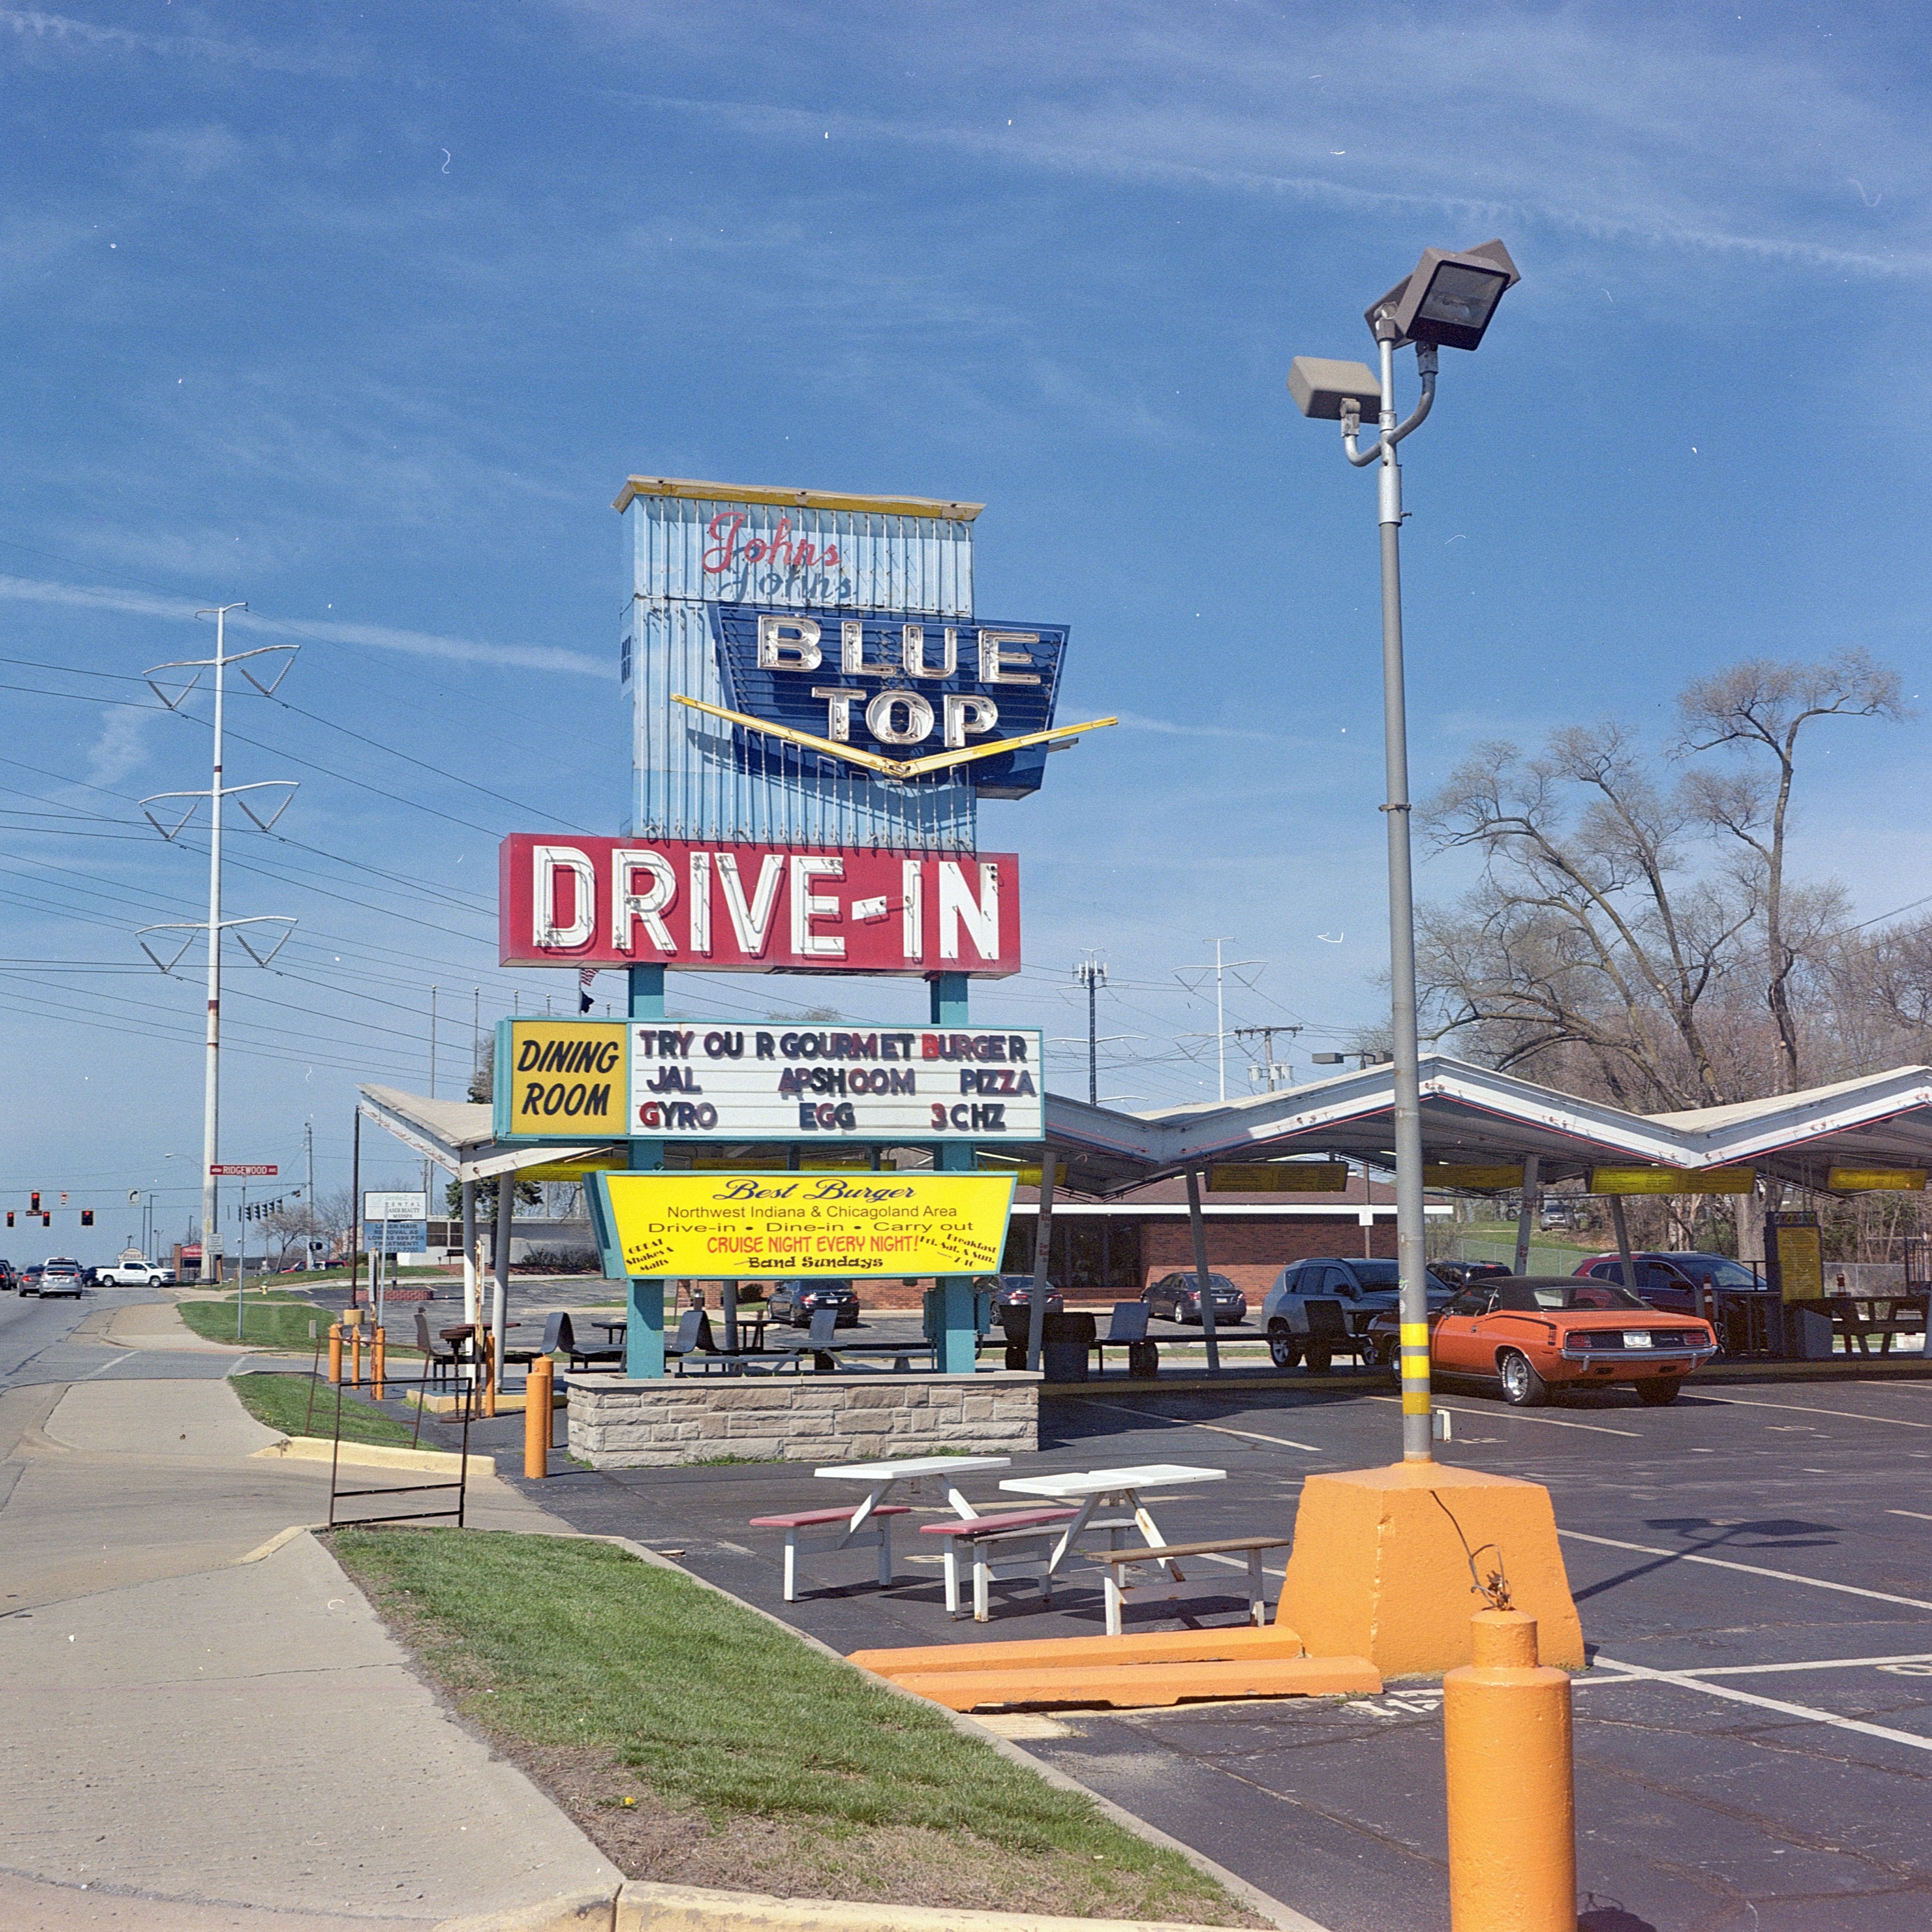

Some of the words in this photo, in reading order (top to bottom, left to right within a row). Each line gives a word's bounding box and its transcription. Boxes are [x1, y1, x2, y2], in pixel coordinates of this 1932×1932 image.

[702, 511, 841, 573] Johns
[758, 614, 1040, 684] BLUE
[811, 686, 998, 747] TOP
[533, 845, 999, 960] DRIVE-IN
[517, 1040, 619, 1073] DINING
[639, 1030, 695, 1056] TRY
[922, 1034, 1027, 1060] BURGER
[646, 1066, 701, 1092] JAL
[778, 1067, 916, 1094] APSHOOM
[960, 1069, 1037, 1095] PIZZA
[521, 1082, 611, 1116] ROOM
[639, 1101, 718, 1127] GYRO
[799, 1102, 855, 1129] EGG
[223, 1166, 267, 1174] RIDGEWOOD
[712, 1179, 799, 1200] Best
[803, 1179, 916, 1203] Burger
[668, 1206, 745, 1218] Northwest
[751, 1206, 805, 1218] Indiana
[811, 1206, 822, 1218] &
[826, 1206, 919, 1220] Chicagoland
[923, 1206, 957, 1217] Area
[649, 1223, 736, 1232] Drive-in
[767, 1222, 844, 1232] Dine-in
[874, 1222, 933, 1233] Carry
[940, 1222, 974, 1231] out
[707, 1236, 763, 1253] CRUISE
[768, 1236, 811, 1252] NIGHT
[817, 1236, 866, 1252] EVERY
[870, 1235, 919, 1252] NIGHT!
[920, 1236, 938, 1246] Fri.
[941, 1242, 960, 1253] Sat.
[973, 1251, 995, 1264] Sun.
[947, 1233, 996, 1253] Breakfast
[626, 1250, 665, 1265] Shakes
[640, 1259, 669, 1271] Malts
[748, 1256, 796, 1268] Band
[802, 1255, 884, 1268] Sundays
